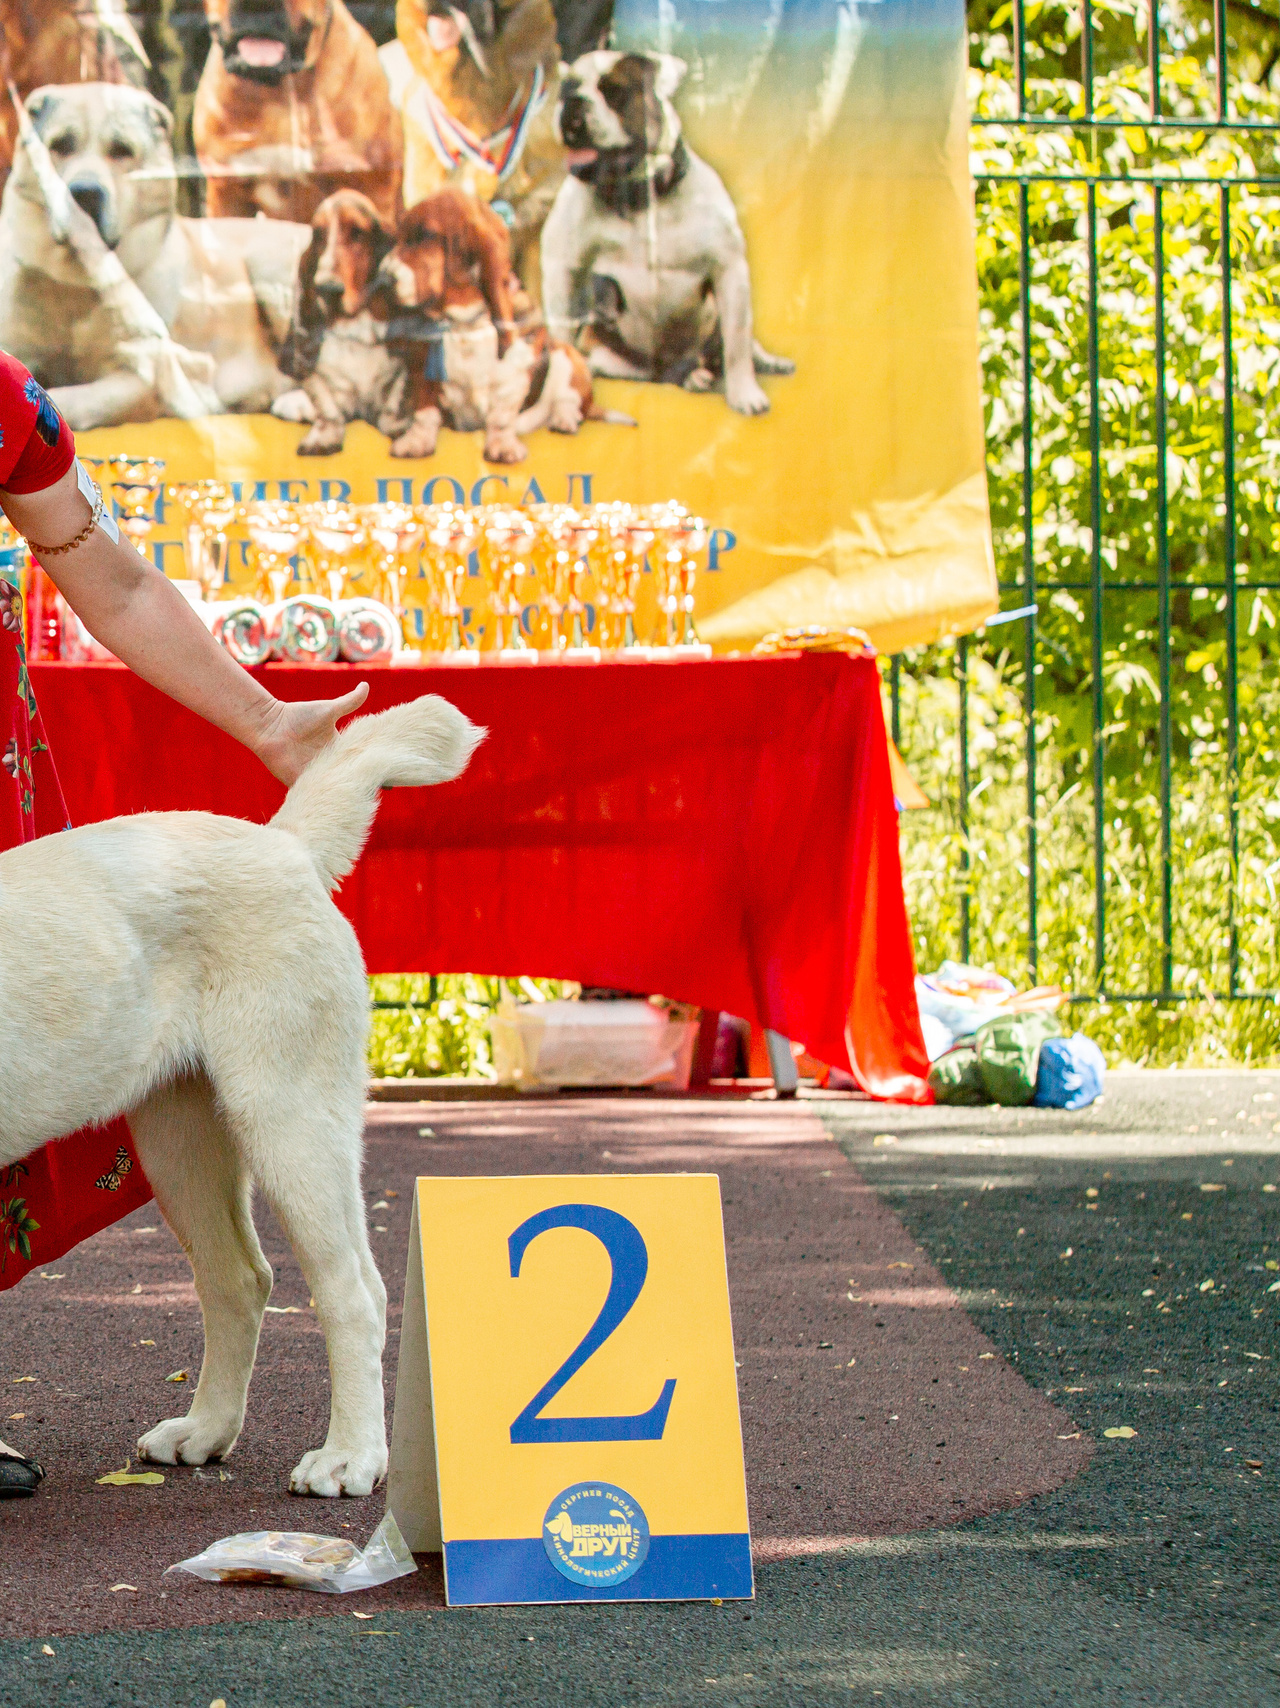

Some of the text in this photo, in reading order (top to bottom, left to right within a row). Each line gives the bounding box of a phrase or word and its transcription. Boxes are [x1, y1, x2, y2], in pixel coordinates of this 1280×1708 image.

[507, 1203, 677, 1444] 2
[560, 1489, 635, 1518] СЕРГИЕВ ПОСАД
[553, 1528, 640, 1578] КИНОЛОГИЧЕСКИЙ ЦЕНТР
[569, 1536, 632, 1557] ДРУГ
